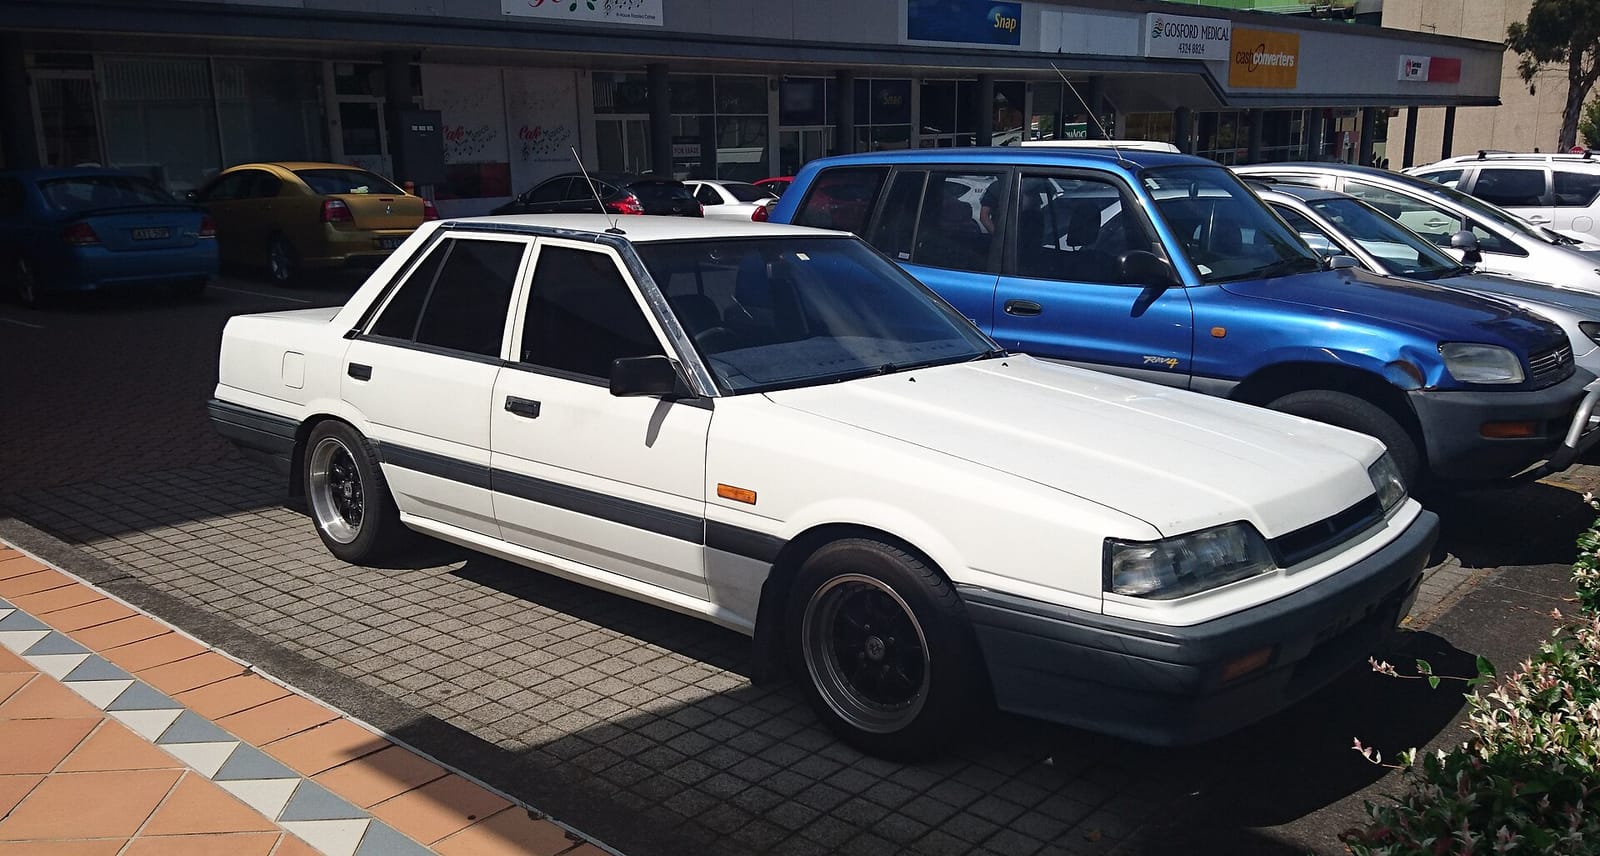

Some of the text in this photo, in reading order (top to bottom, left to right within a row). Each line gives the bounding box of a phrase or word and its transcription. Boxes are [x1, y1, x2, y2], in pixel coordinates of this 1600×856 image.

[993, 12, 1017, 33] Snap
[1164, 22, 1230, 41] GOSFORD MEDICAL
[1178, 42, 1205, 55] 4324 8824
[1235, 50, 1295, 67] cash converters
[1143, 355, 1179, 369] RAV4
